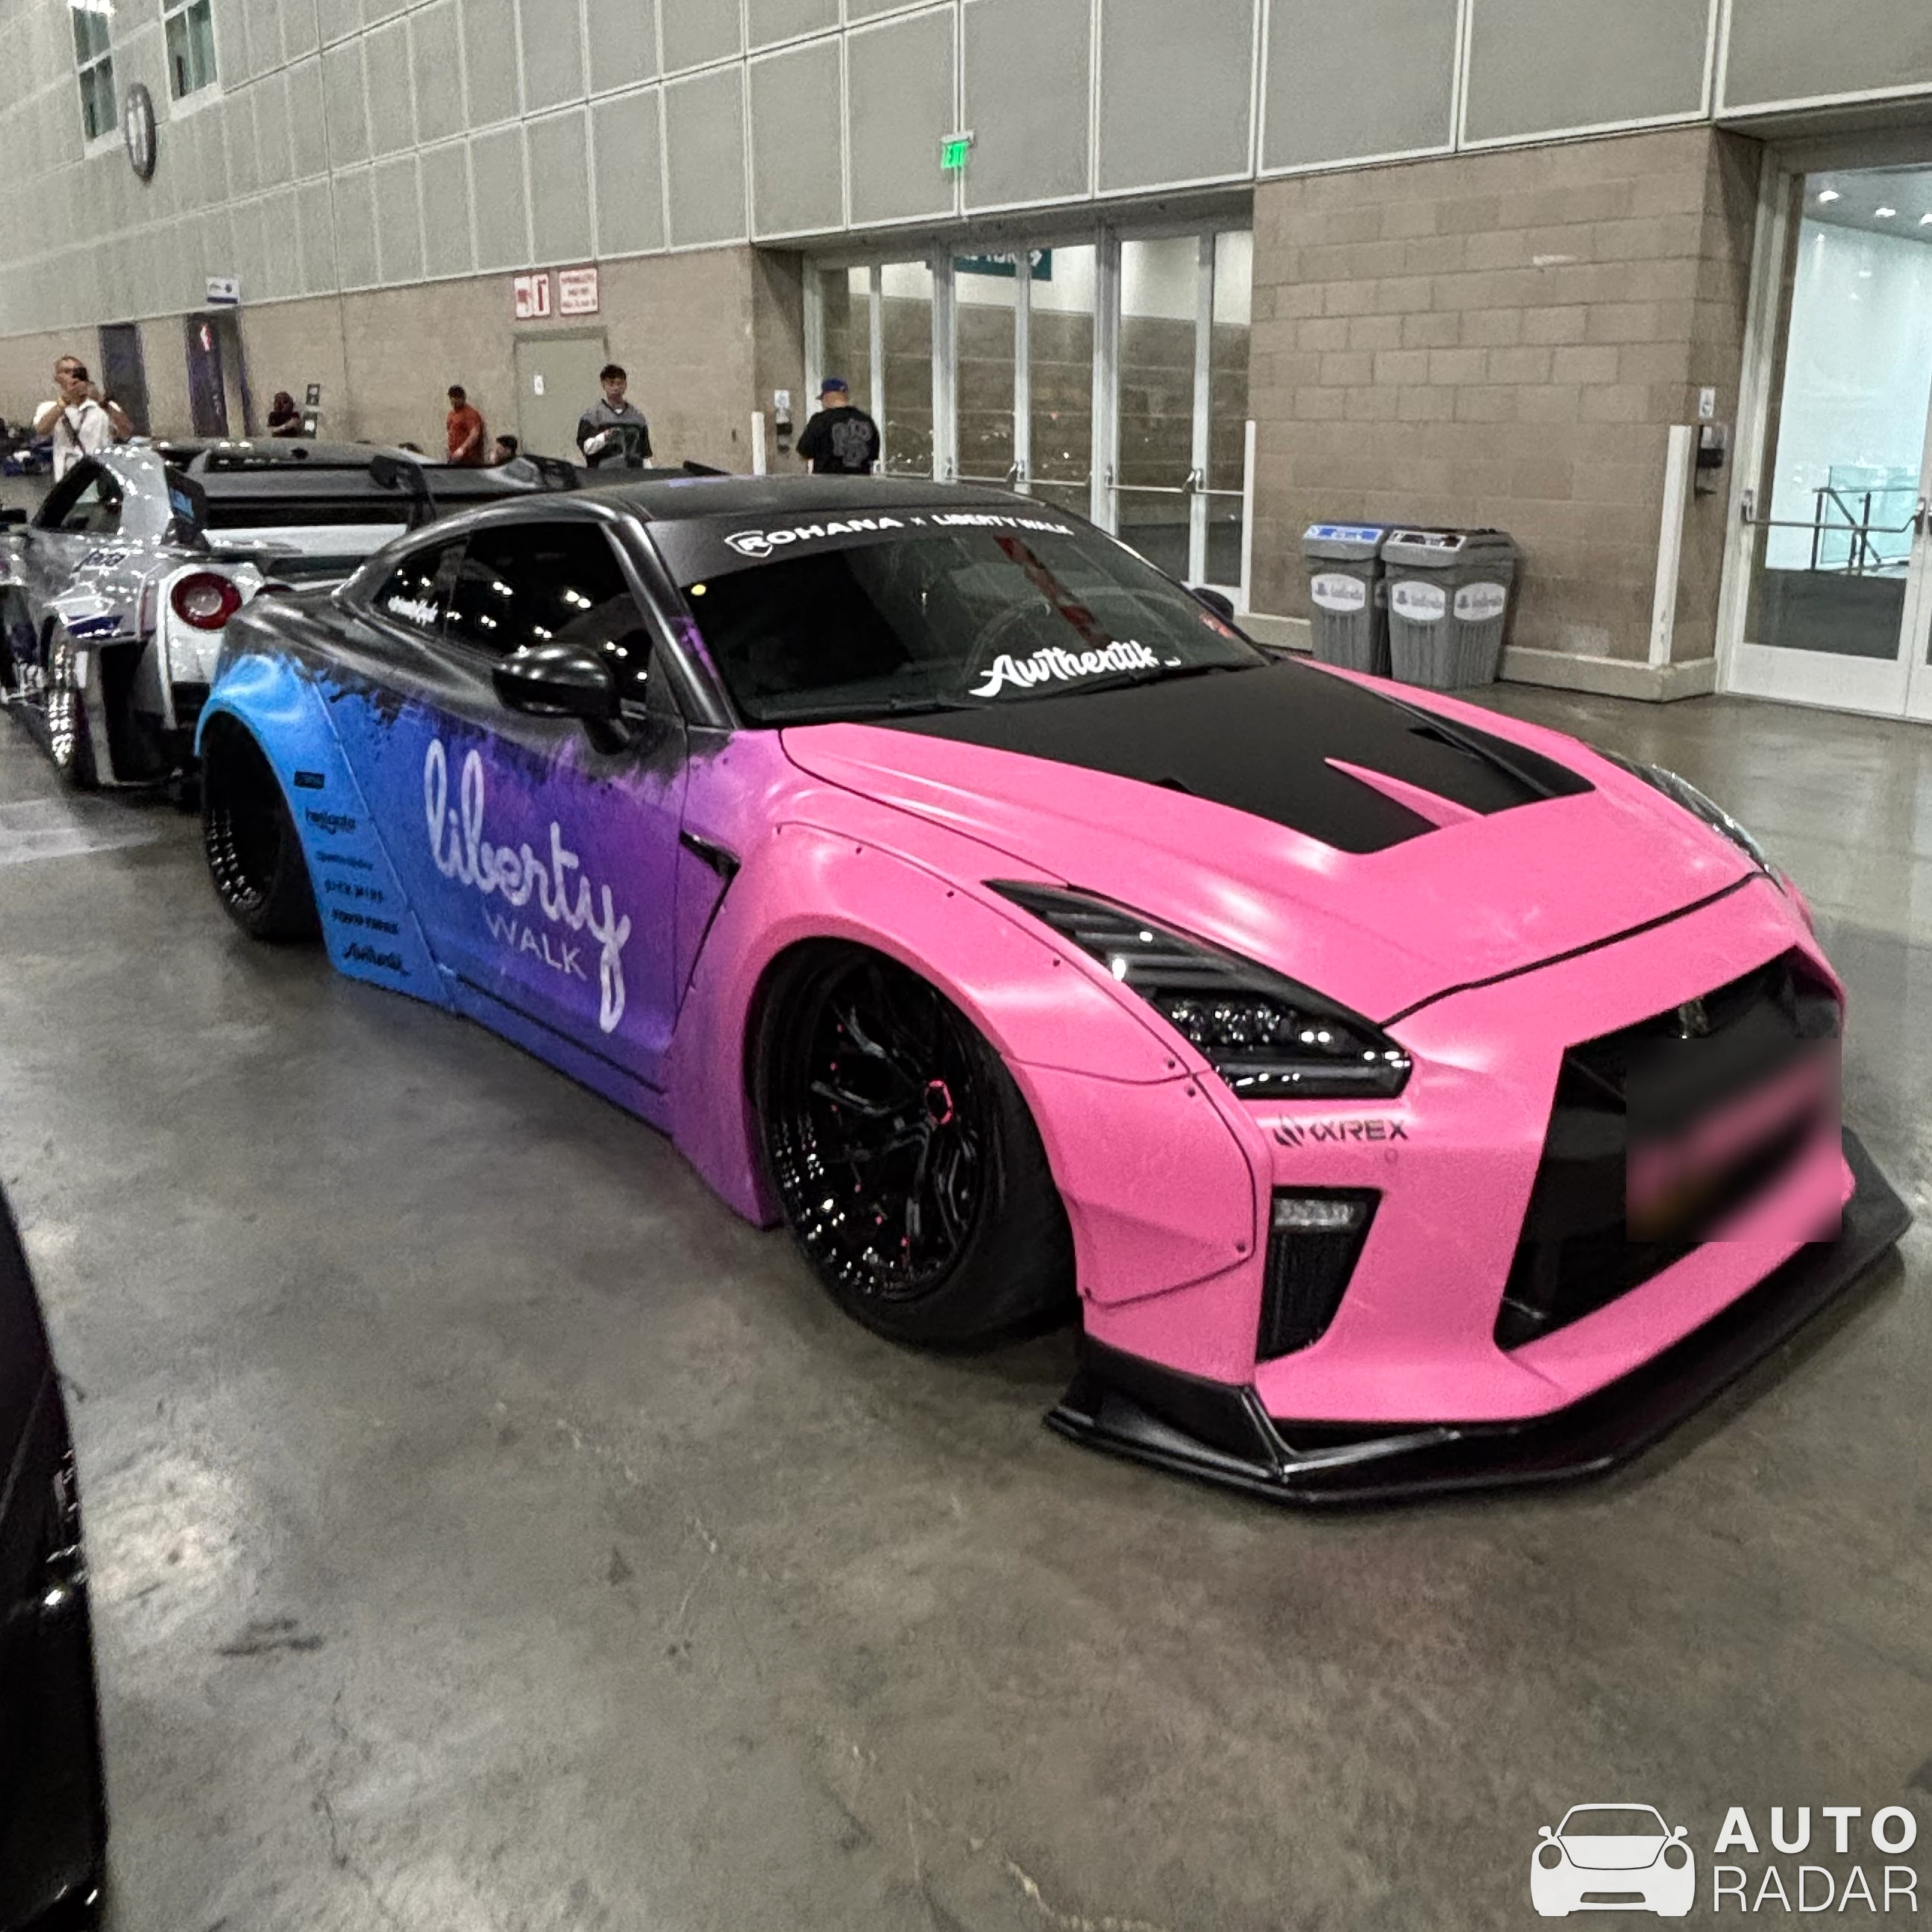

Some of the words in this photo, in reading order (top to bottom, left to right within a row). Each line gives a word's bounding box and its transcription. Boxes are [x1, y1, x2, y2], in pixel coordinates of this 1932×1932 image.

[738, 517, 904, 551] ROHANA
[931, 514, 1017, 527] LIBERTY
[1015, 518, 1074, 535] WALK
[424, 738, 631, 1033] liberty
[483, 909, 587, 981] WALK
